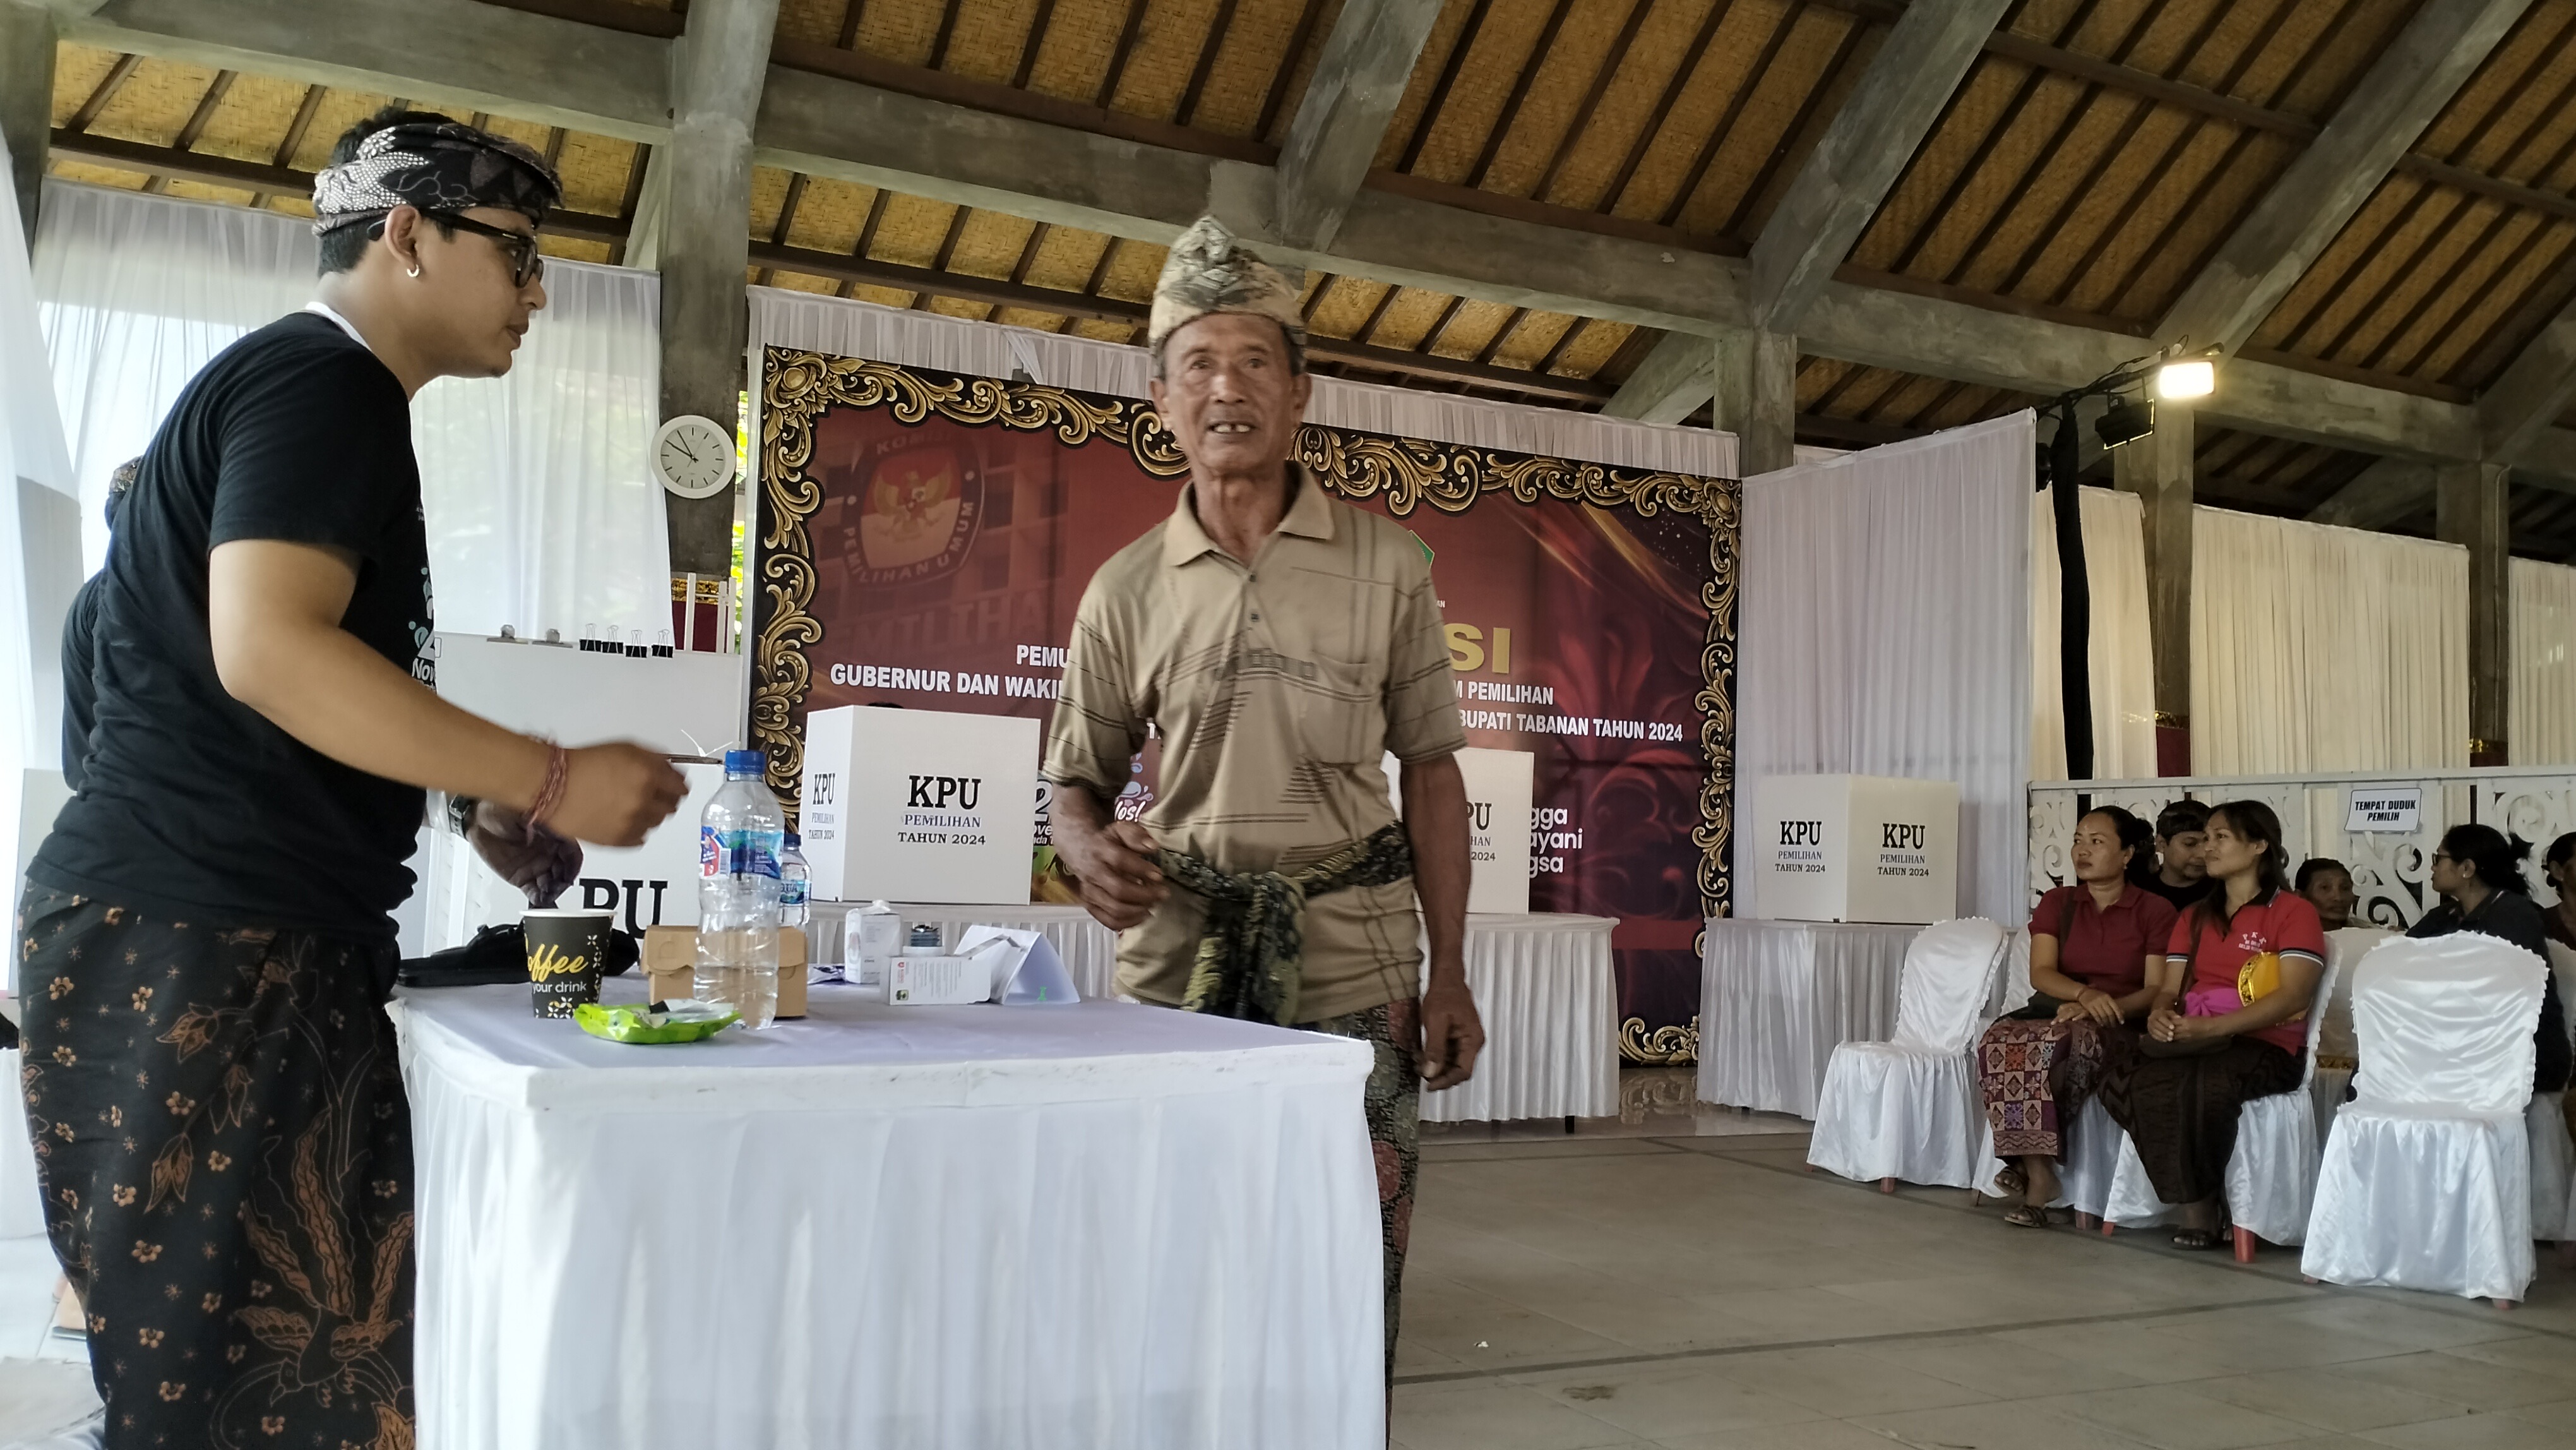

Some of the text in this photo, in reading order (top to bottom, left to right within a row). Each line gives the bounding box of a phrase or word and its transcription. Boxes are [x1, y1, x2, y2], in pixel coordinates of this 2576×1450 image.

[937, 502, 975, 568] UMUM
[830, 662, 950, 693] GUBERNUR
[957, 671, 999, 695] DAN
[1468, 681, 1554, 705] PEMILIHAN
[1517, 714, 1589, 736] TABANAN
[1593, 718, 1644, 740] TAHUN
[1649, 722, 1683, 742] 2024
[812, 773, 836, 805] KPU
[907, 775, 982, 810] KPU
[2355, 800, 2416, 811] TEMPAT DUDUK
[904, 814, 981, 828] PEMILIHAN
[2366, 812, 2400, 822] PEMILIH
[898, 832, 986, 846] TAHUN 2024
[1780, 820, 1822, 846] KPU
[1882, 822, 1926, 850] KPU
[1470, 851, 1496, 861] 2024
[1778, 850, 1822, 860] PEMILIHAN
[1880, 854, 1925, 864] PEMILIHAN
[1775, 863, 1826, 873] TAHUN 2024
[1877, 866, 1929, 877] TAHUN 2024
[529, 878, 668, 939] PU
[525, 933, 588, 983] offee
[532, 980, 587, 994] your drink
